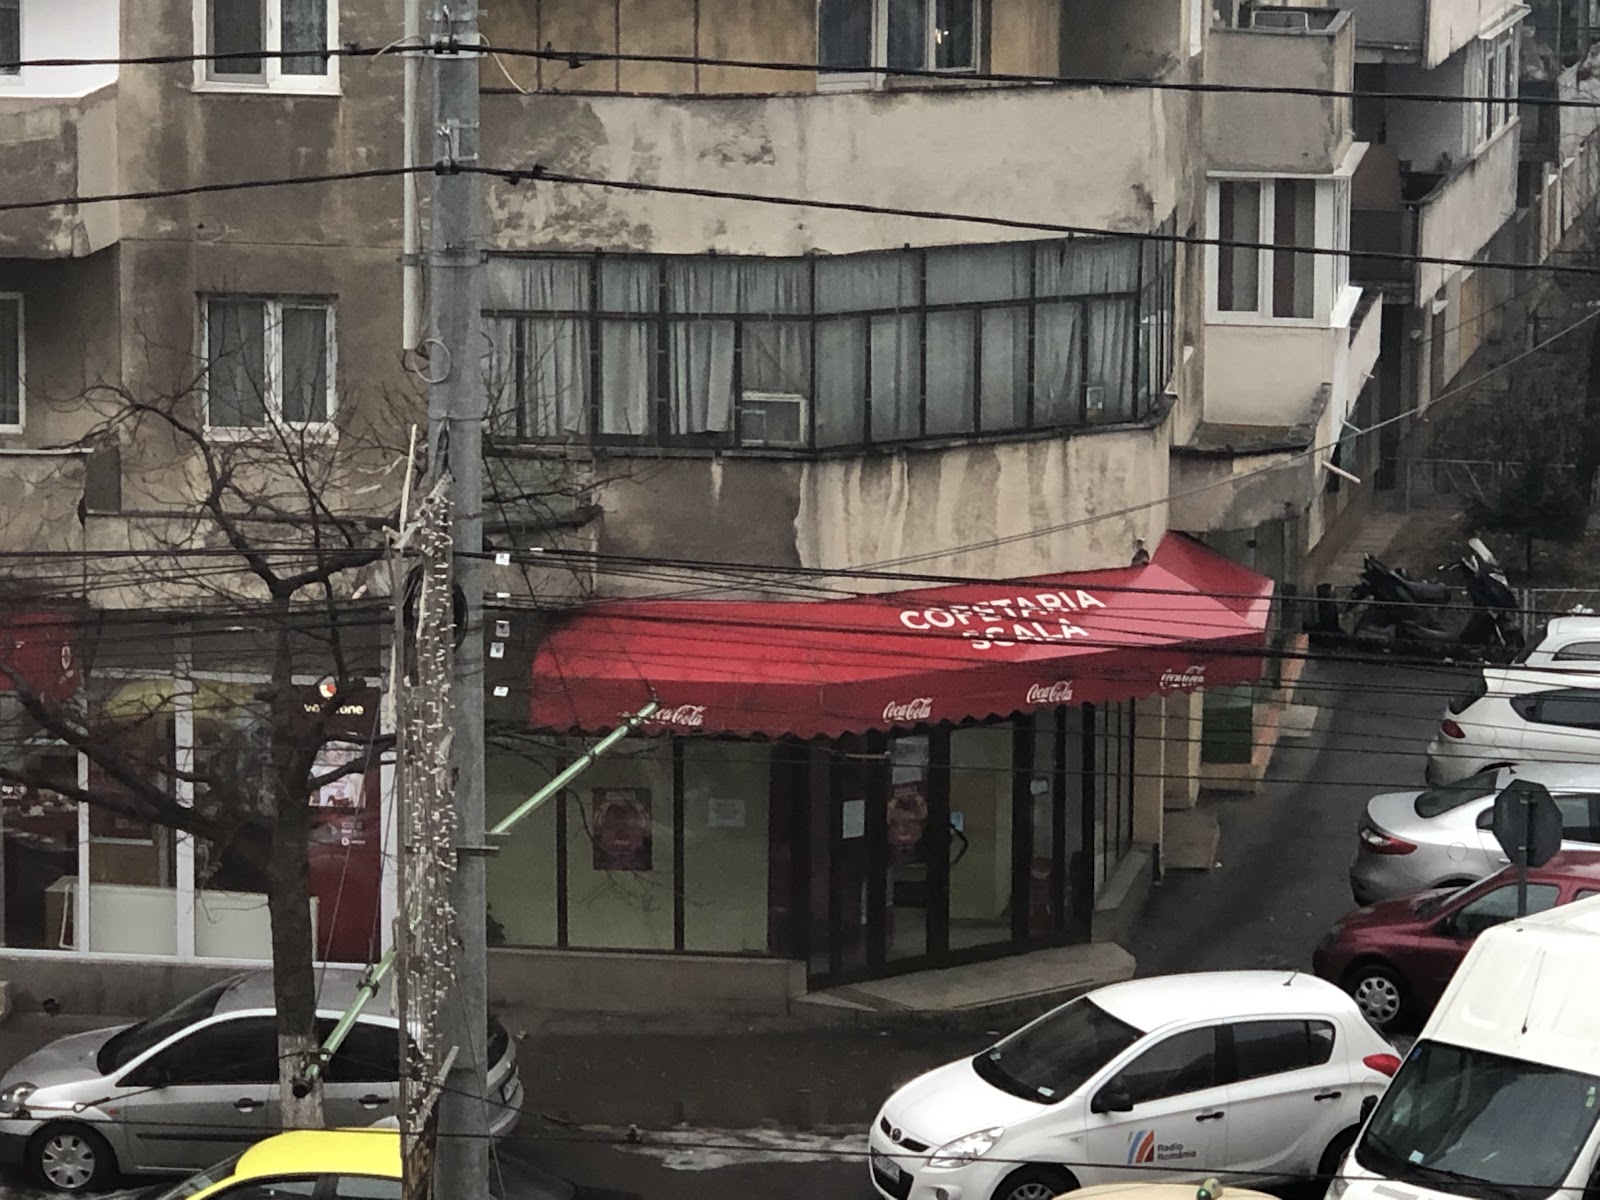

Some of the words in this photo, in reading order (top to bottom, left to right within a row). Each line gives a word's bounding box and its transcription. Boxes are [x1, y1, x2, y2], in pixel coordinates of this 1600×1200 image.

[900, 590, 1106, 630] COFETARIA
[962, 618, 1090, 650] SCALA
[303, 701, 365, 715] voone
